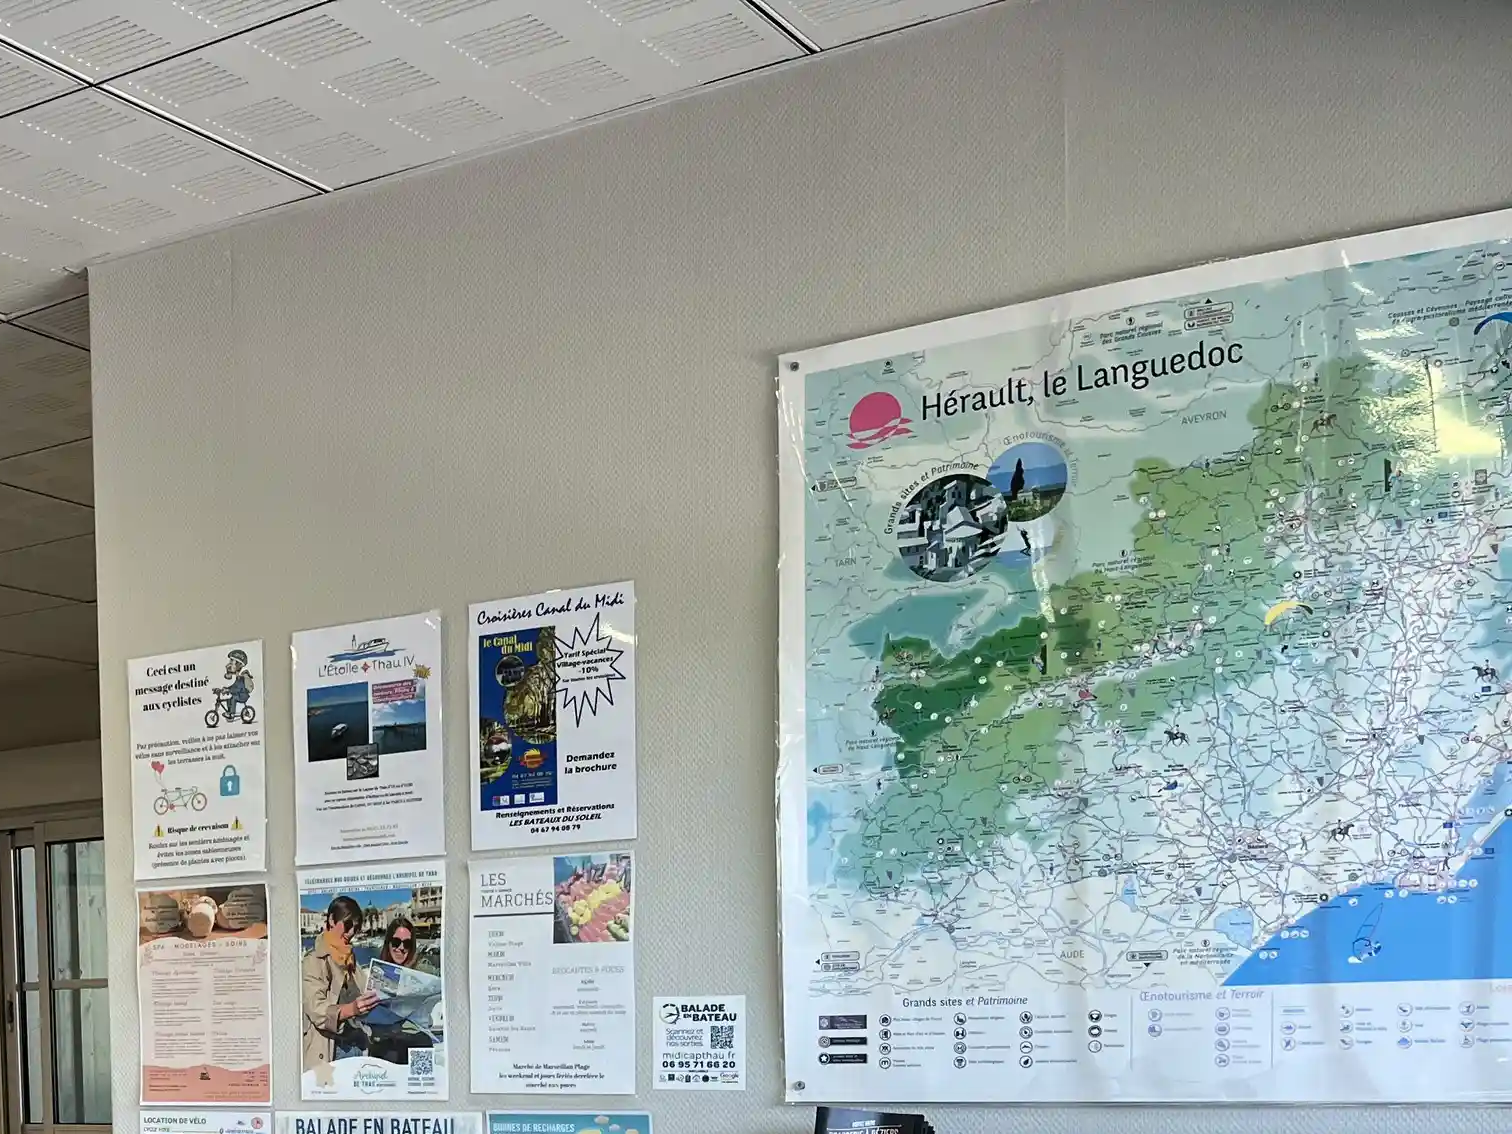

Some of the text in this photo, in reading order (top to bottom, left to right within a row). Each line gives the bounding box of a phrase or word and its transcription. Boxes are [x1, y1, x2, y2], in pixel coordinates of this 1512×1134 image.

[922, 341, 1243, 420] Hérault, le Languedoc
[1181, 410, 1227, 426] AVEYRON
[884, 461, 980, 535] Grands sites et Patrimoine
[835, 557, 857, 568] TARN
[478, 592, 624, 625] Croisières Canal du Midi
[563, 648, 607, 659] Tarif Spécial
[146, 663, 196, 677] Ceci est un
[135, 676, 209, 696] message destiné
[143, 696, 202, 712] aux cyclistes
[566, 751, 615, 762] Demandez
[575, 763, 617, 773] brochure
[496, 808, 555, 818] Renseignements
[567, 803, 615, 813] Réservations
[524, 816, 561, 825] BATEAUX
[575, 813, 602, 821] SOLEIL
[168, 826, 188, 834] Risque
[198, 823, 228, 831] crevaison
[481, 873, 506, 887] LES
[481, 889, 553, 908] MARCHÉS
[1060, 950, 1085, 960] AUDE
[681, 1004, 725, 1012] BALADE
[693, 1013, 737, 1021] BATEAU
